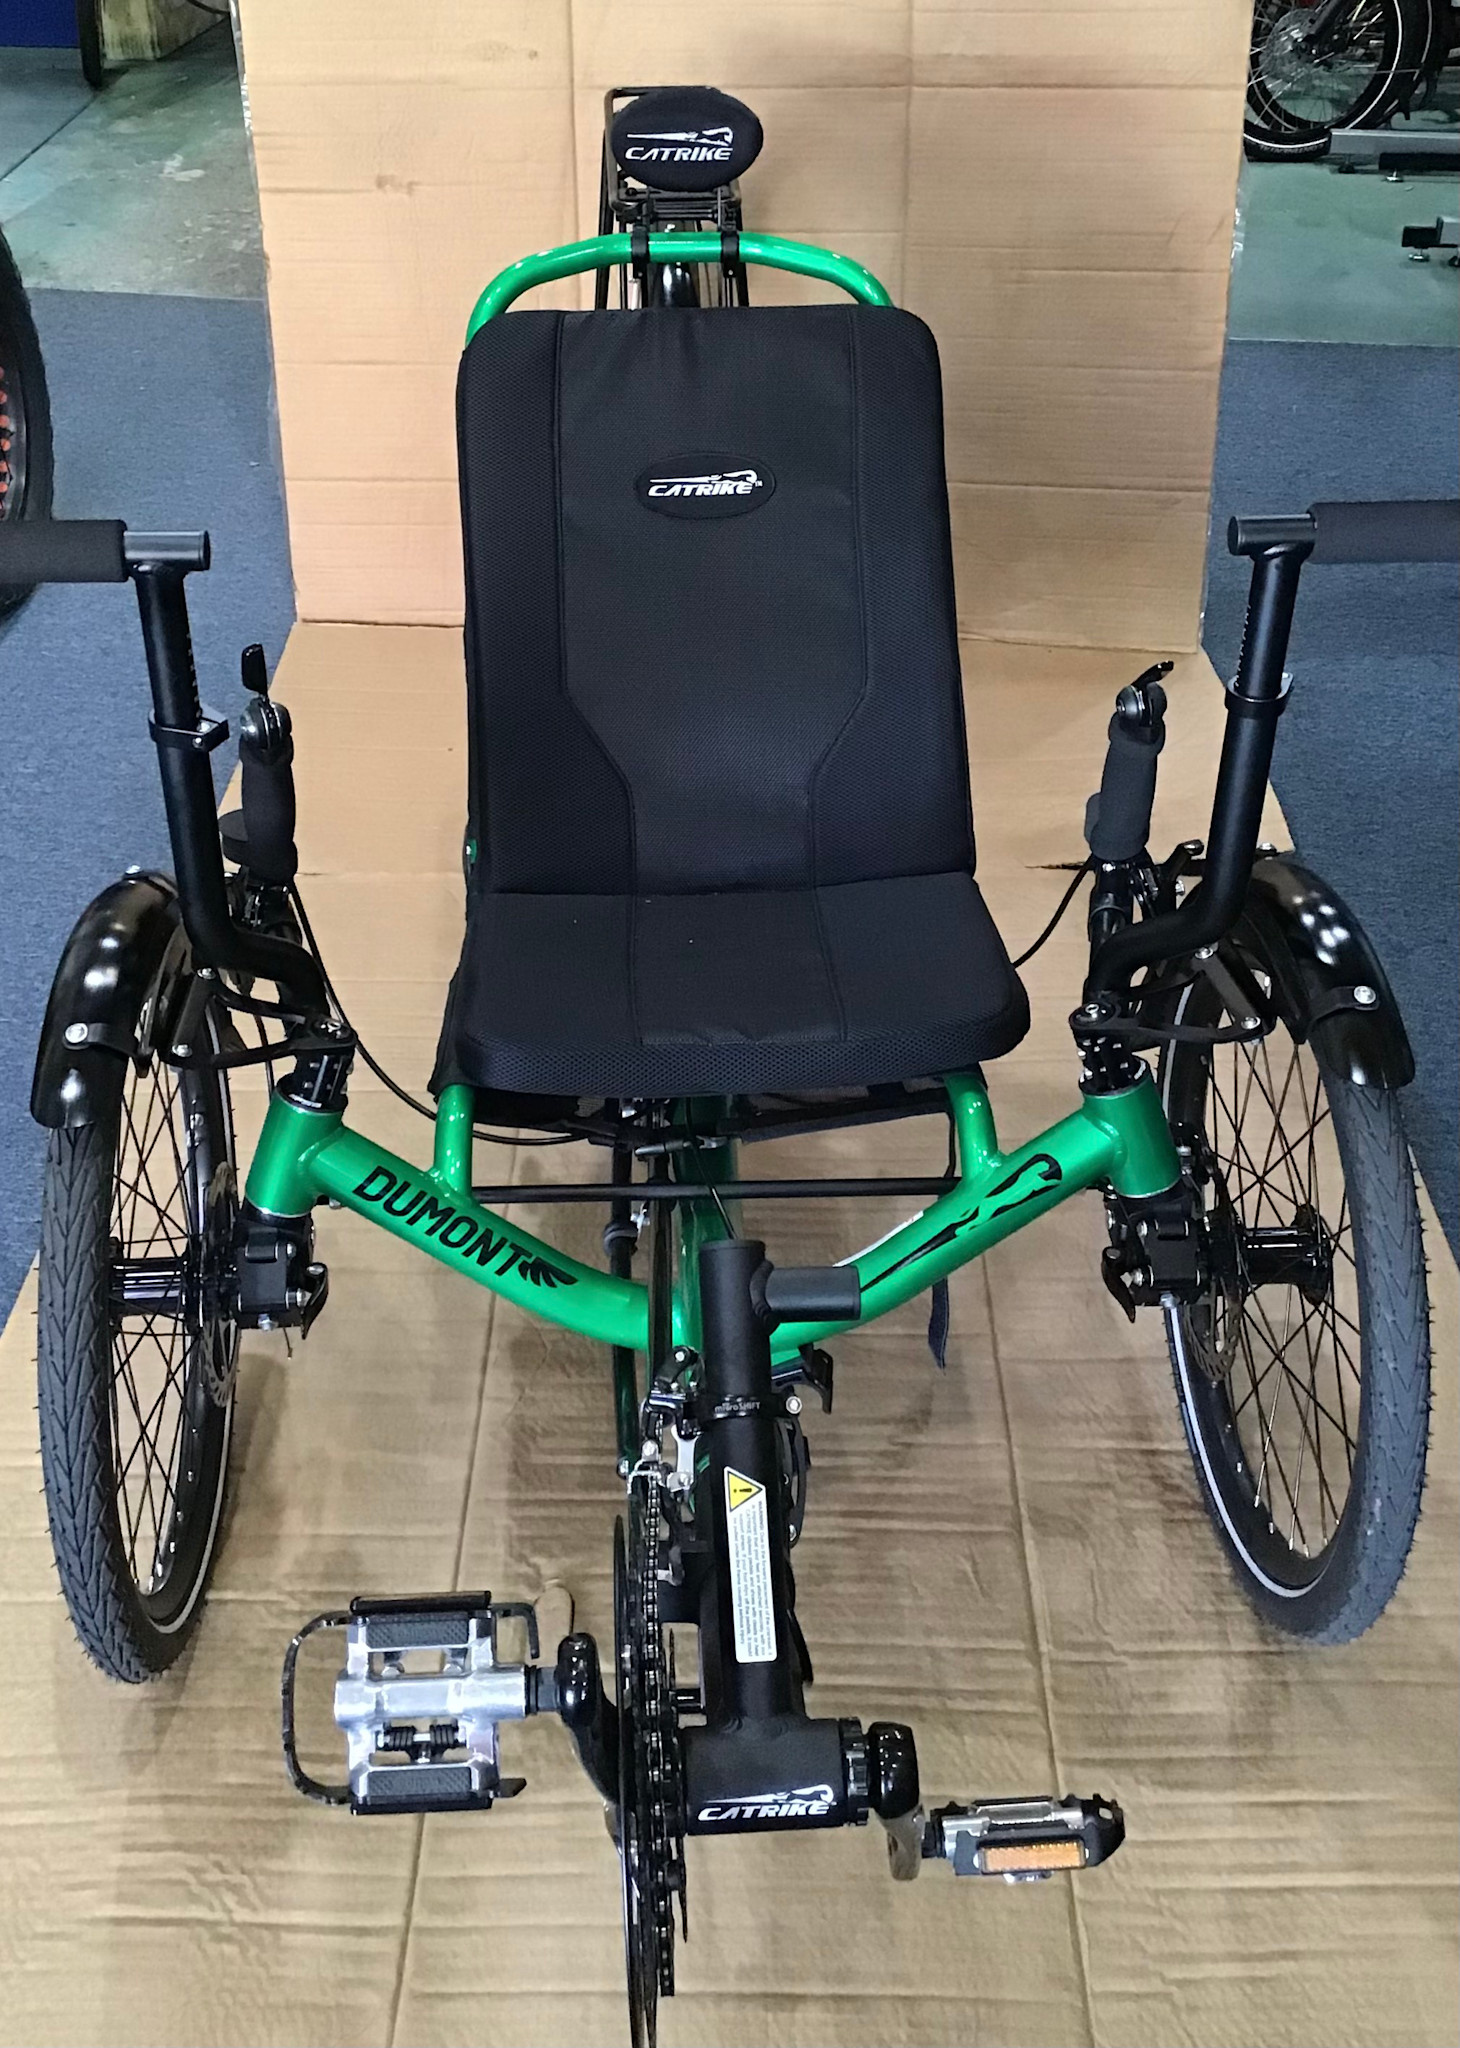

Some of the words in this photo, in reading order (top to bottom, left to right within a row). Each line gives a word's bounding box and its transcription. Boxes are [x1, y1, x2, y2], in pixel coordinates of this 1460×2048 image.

[625, 147, 734, 161] CATRIKE
[647, 483, 753, 497] CATRIKE
[352, 1165, 533, 1277] DUMONT
[698, 1802, 830, 1821] CATRIKE
